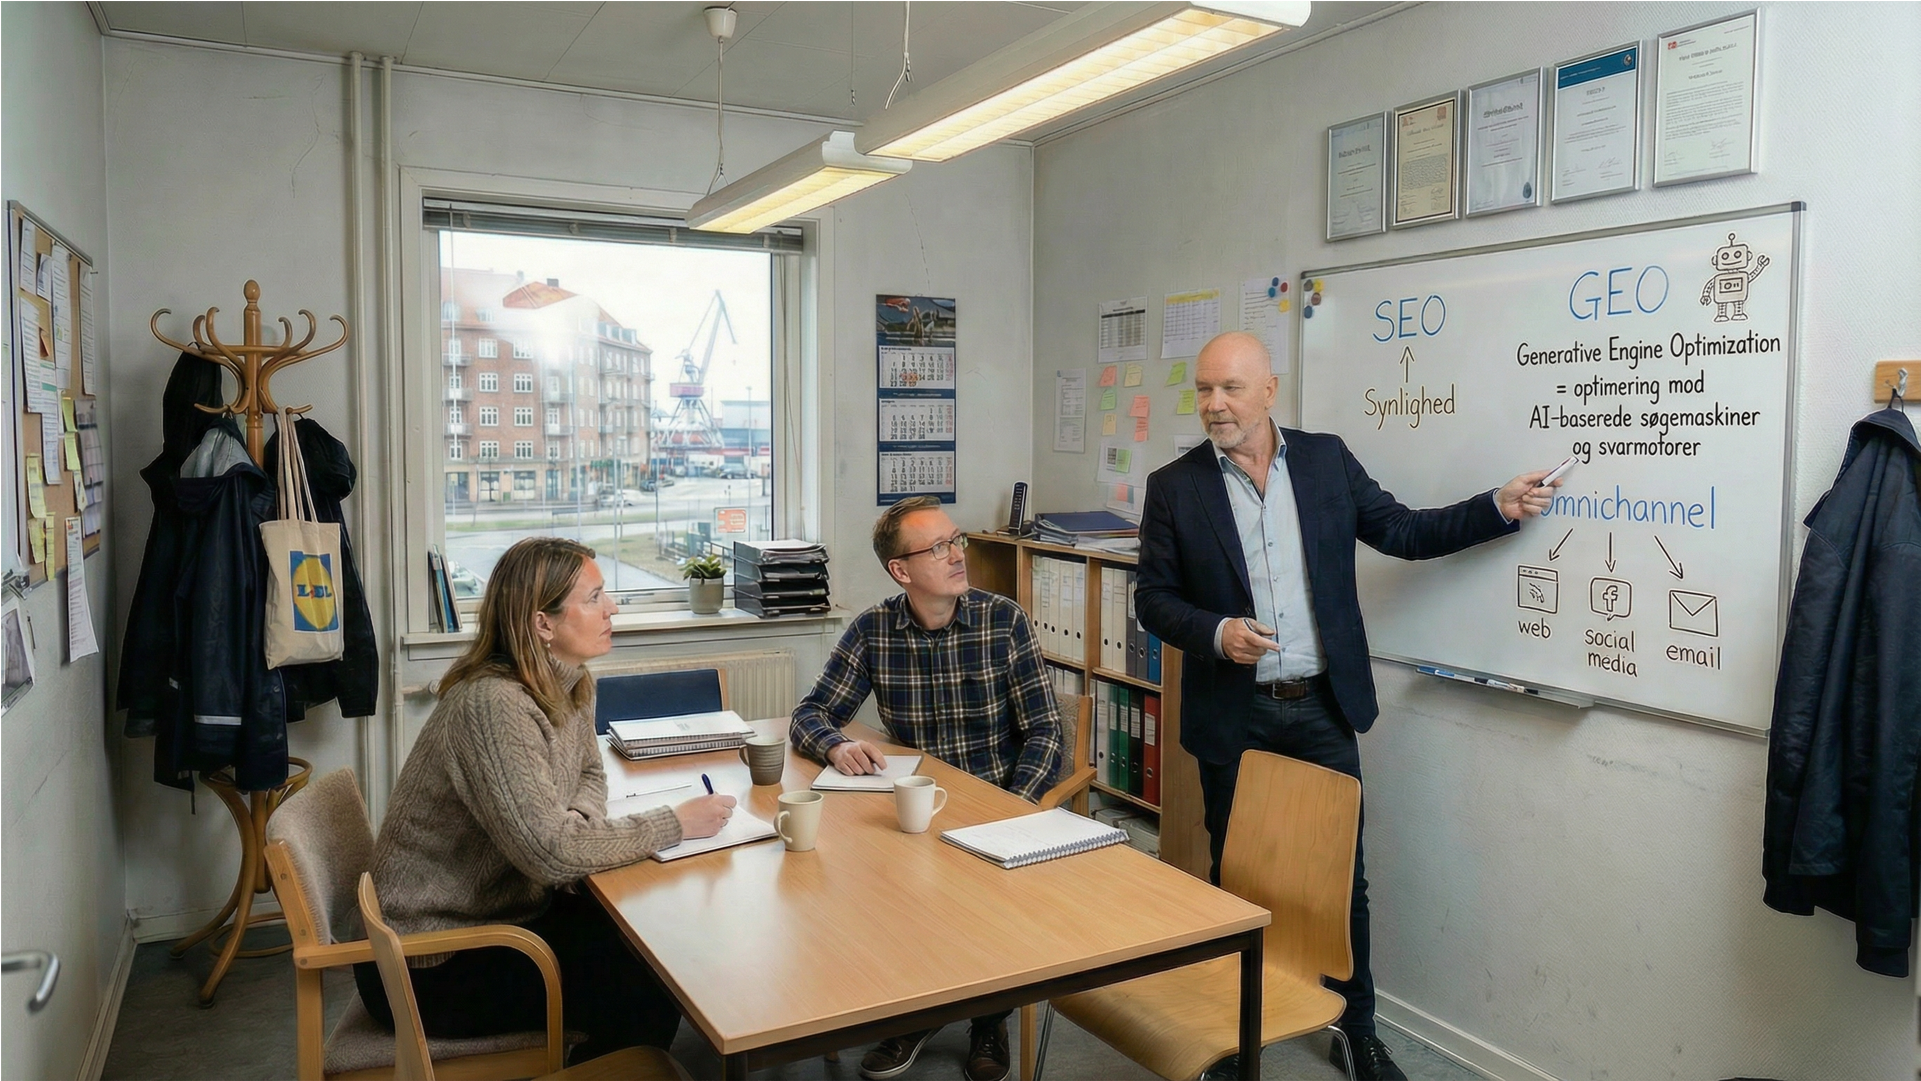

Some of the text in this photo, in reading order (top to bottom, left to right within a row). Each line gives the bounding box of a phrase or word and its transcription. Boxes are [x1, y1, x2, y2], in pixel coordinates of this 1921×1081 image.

[1569, 265, 1670, 321] GEO
[1372, 294, 1446, 342] SEO
[1516, 330, 1781, 370] Generative Engine Optimization
[1573, 376, 1660, 404] optimering
[1668, 369, 1705, 395] mod
[1364, 383, 1456, 430] Synlighed
[1529, 402, 1761, 436] AI-baserede søgemaskiner
[1572, 433, 1702, 465] og svarmotorer
[1517, 617, 1552, 639] web
[1584, 629, 1636, 653] social
[1587, 652, 1638, 678] media
[1666, 645, 1721, 670] email
